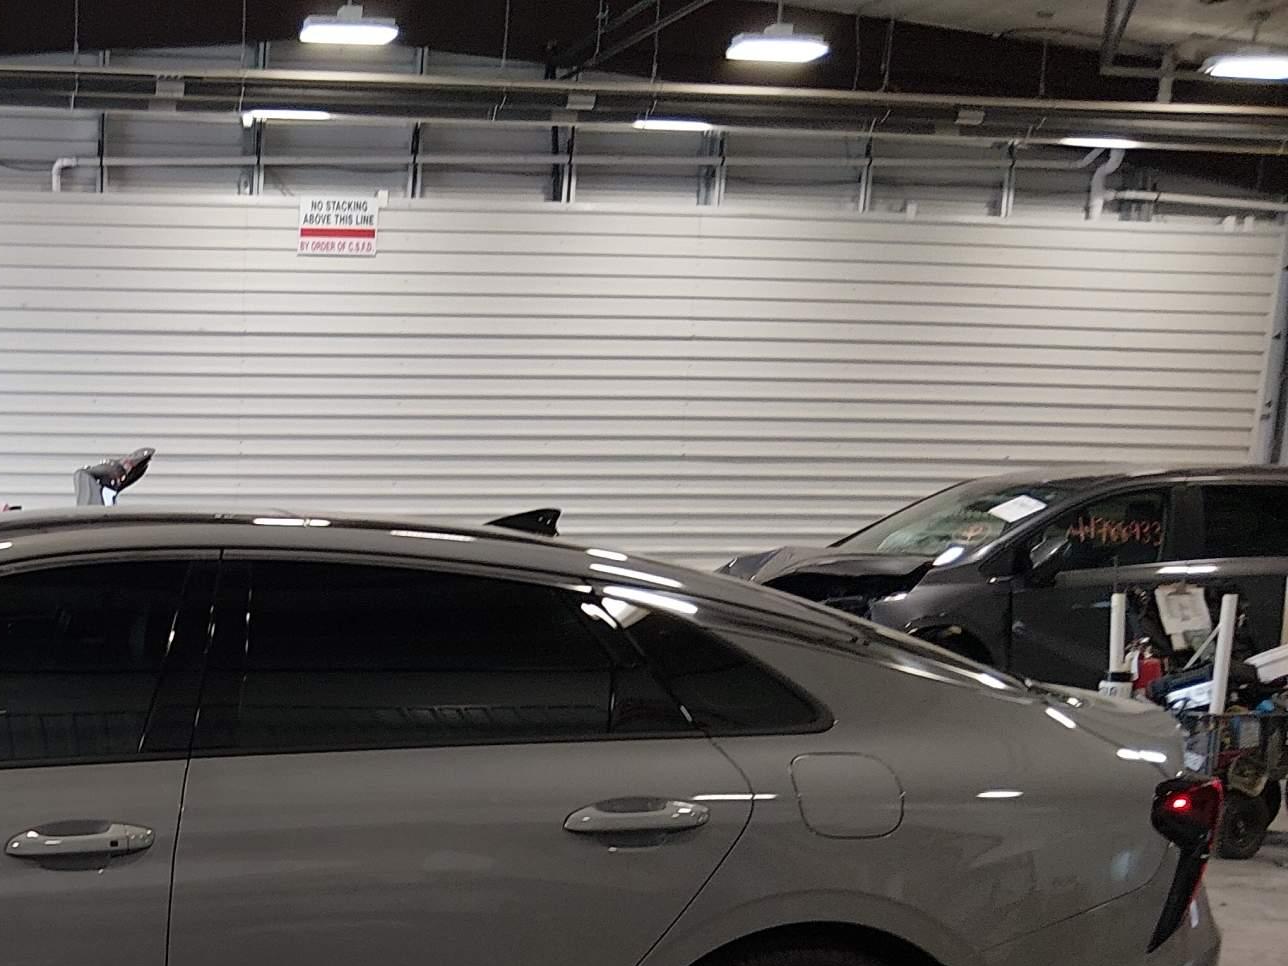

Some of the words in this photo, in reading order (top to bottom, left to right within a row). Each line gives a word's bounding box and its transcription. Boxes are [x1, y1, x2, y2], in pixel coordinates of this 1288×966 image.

[310, 199, 323, 212] NO
[326, 199, 368, 212] STACKING
[303, 213, 331, 225] ABOVE
[335, 214, 353, 225] THIS
[355, 214, 375, 226] LINE
[300, 240, 309, 251] BY
[311, 240, 335, 252] ORDER
[337, 241, 346, 252] OF
